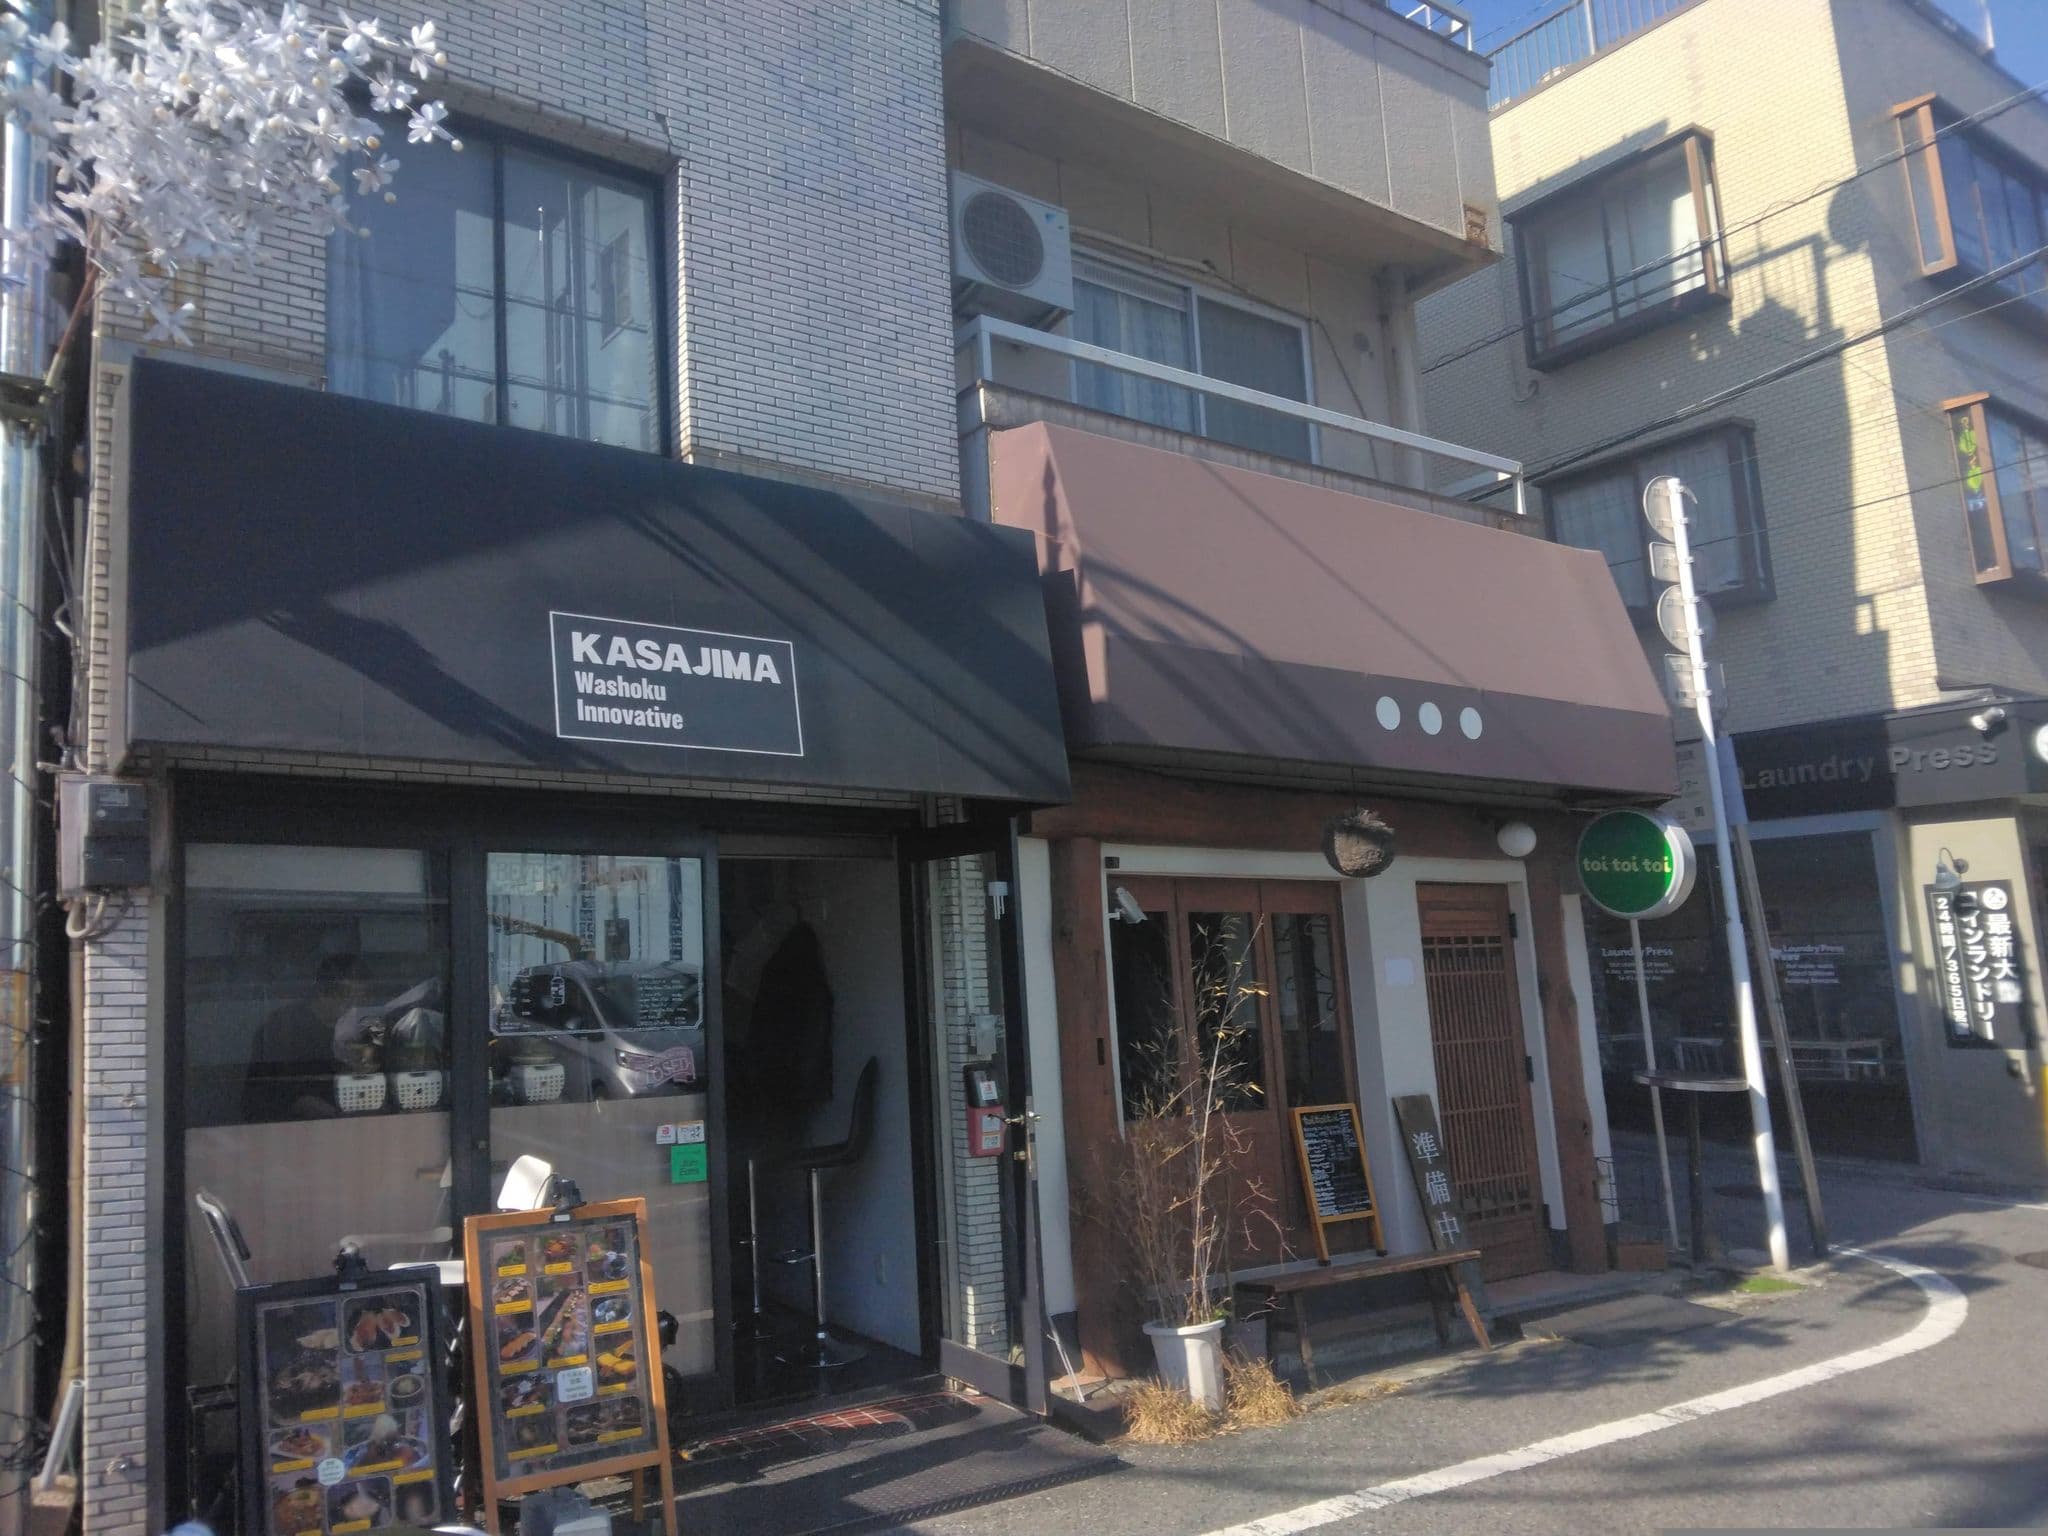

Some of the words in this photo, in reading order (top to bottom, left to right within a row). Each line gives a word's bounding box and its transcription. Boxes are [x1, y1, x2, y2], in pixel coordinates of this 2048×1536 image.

[571, 631, 782, 685] KASAJIMA
[575, 671, 667, 701] Washoku
[577, 698, 684, 730] Innovative
[1741, 755, 1874, 789] Laundry
[1889, 743, 1999, 773] Press
[1583, 856, 1609, 872] toi
[1612, 856, 1639, 872] toi
[1642, 856, 1671, 873] toi
[1601, 947, 1645, 960] Laundy
[1936, 897, 1969, 1034] 24時間/365日
[1411, 1131, 1461, 1245] 準備中
